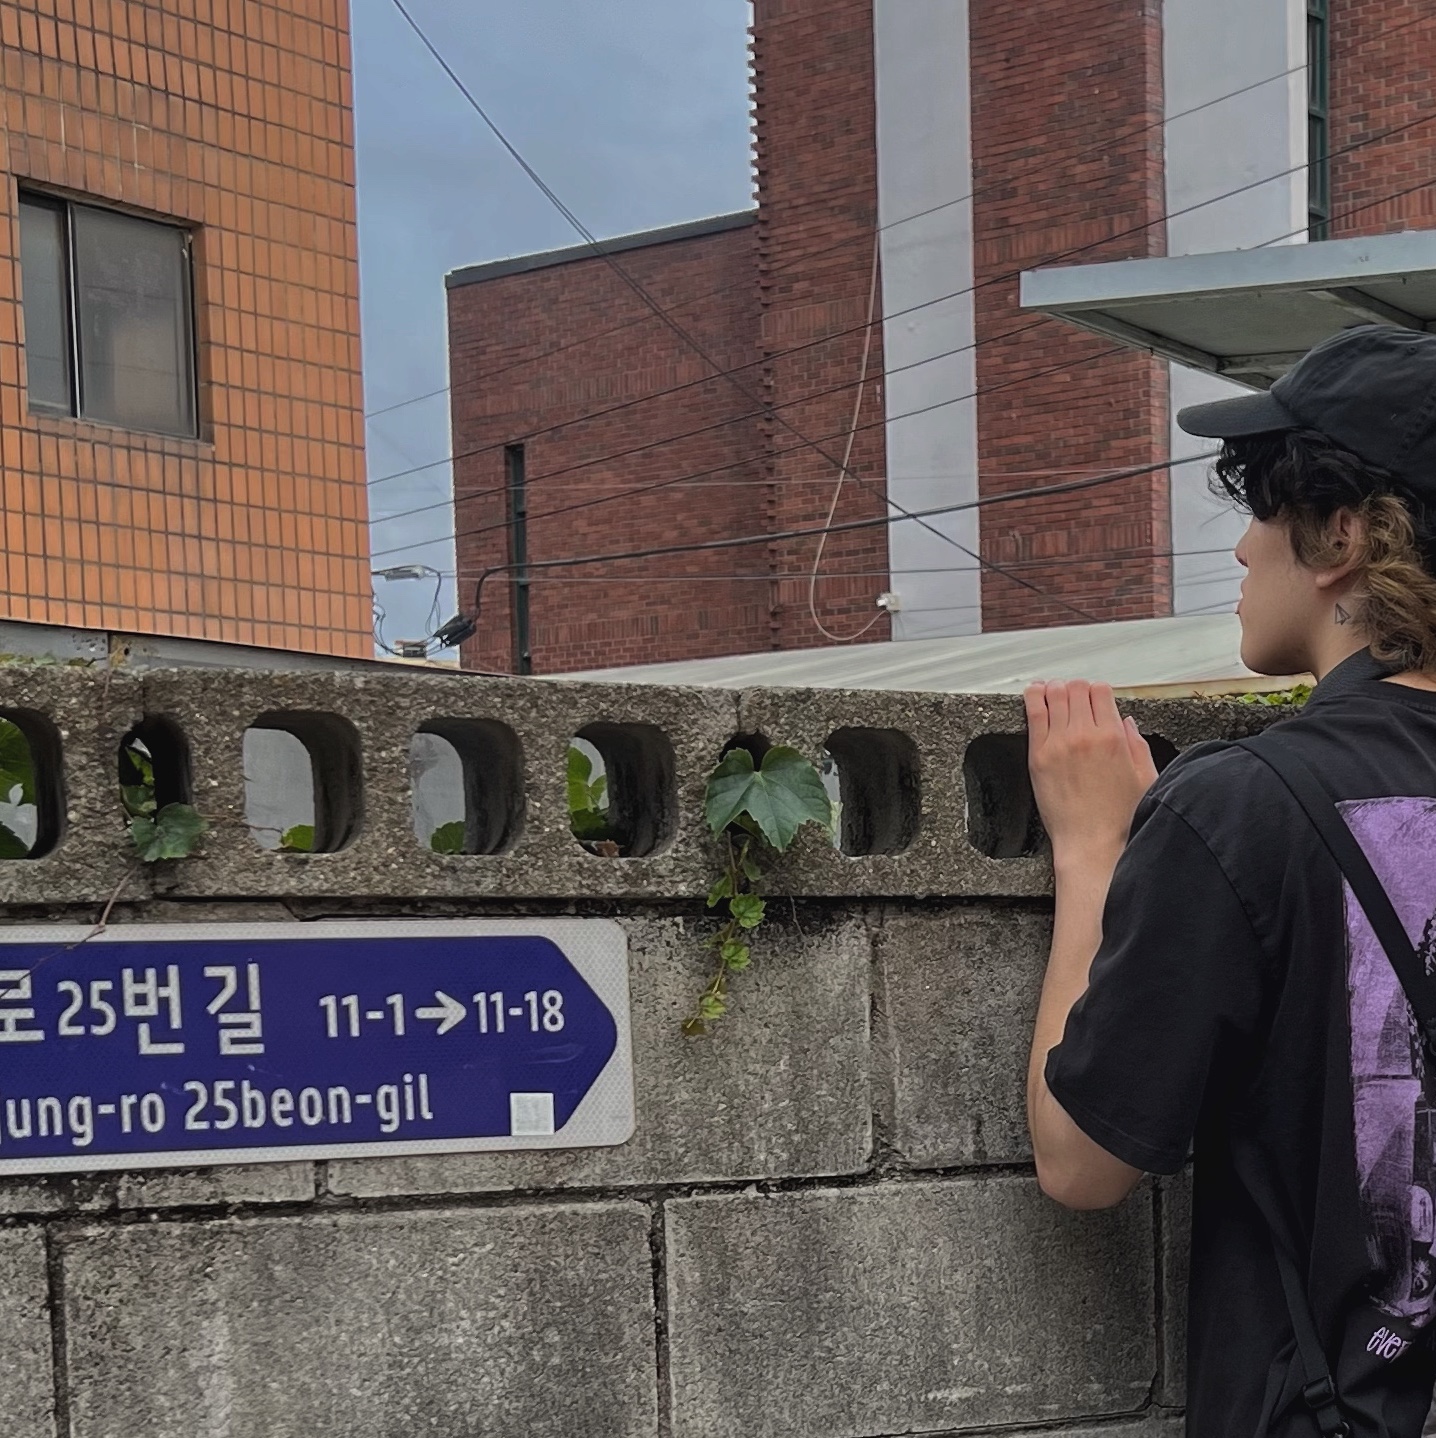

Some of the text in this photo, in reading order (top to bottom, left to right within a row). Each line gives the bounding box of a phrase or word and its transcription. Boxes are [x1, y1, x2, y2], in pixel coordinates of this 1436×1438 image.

[319, 993, 406, 1038] 11-1
[472, 989, 566, 1034] 11-18
[0, 1073, 434, 1147] ung-ro 25beon-gil
